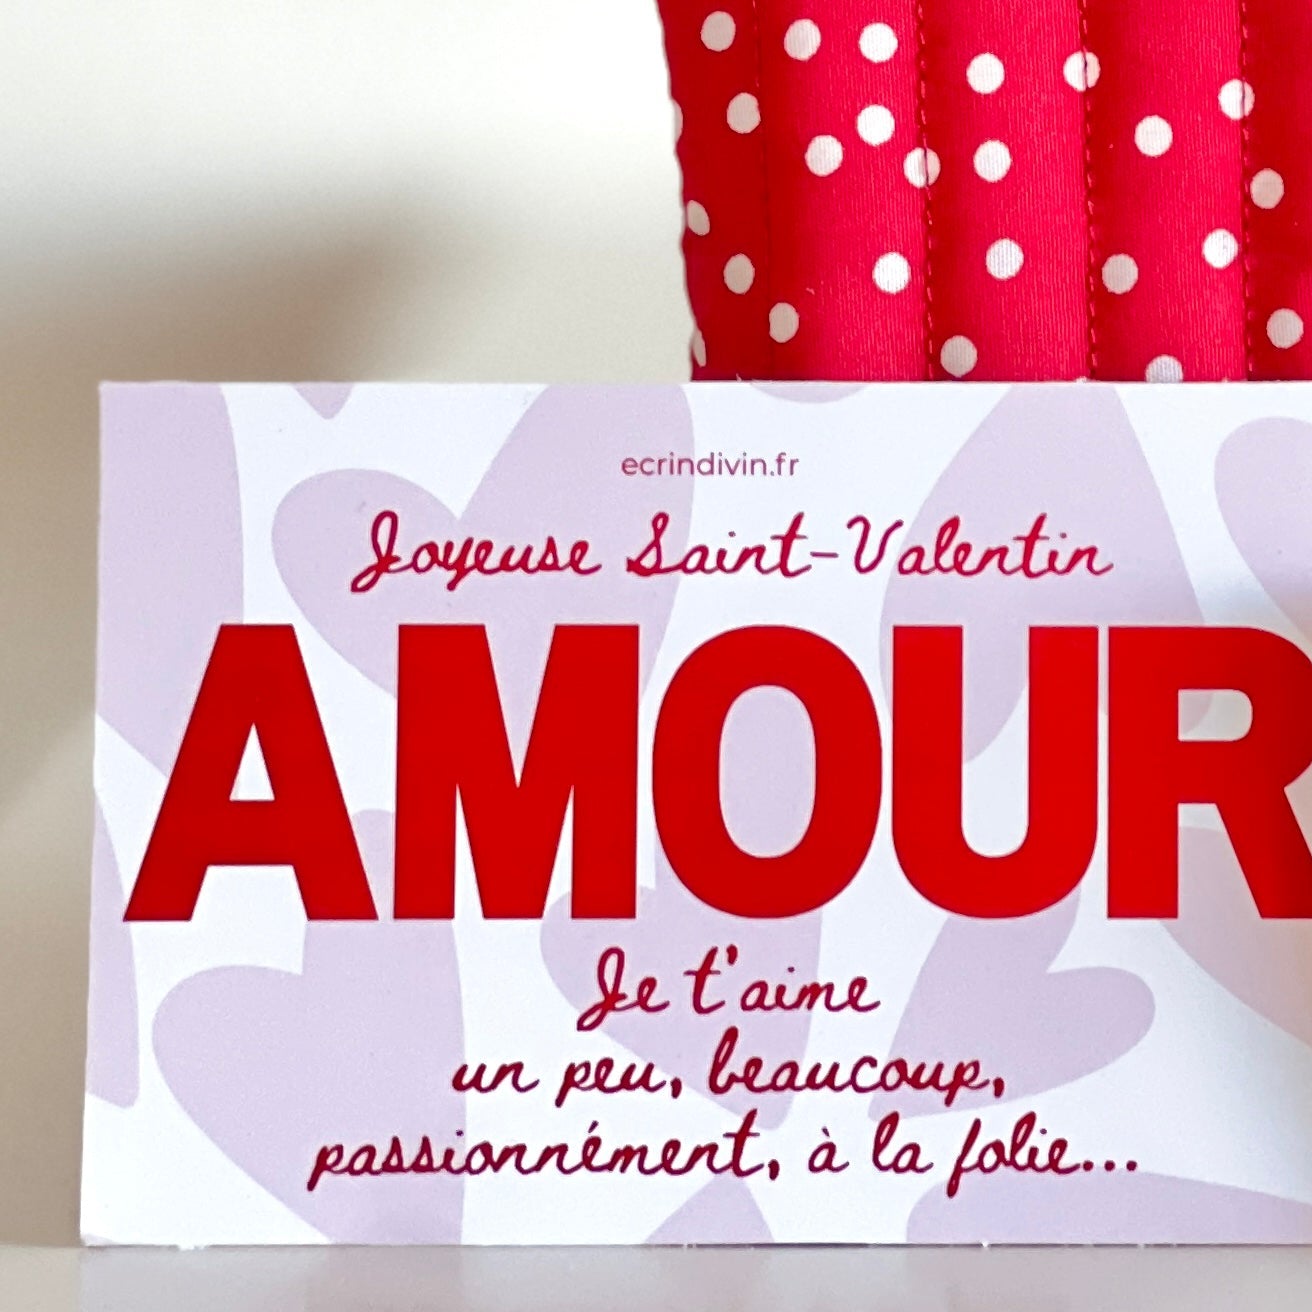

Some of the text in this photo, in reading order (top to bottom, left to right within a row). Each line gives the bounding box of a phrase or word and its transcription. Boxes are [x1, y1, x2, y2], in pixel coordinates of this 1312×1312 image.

[621, 452, 799, 477] ecrindivin.fr
[350, 509, 1114, 594] Joyeuse Saint-Valentin
[576, 943, 881, 1032] Je t'aime
[451, 1025, 1005, 1109] un peu, beaucoup,
[306, 1108, 1138, 1200] passionnément, à la folie...
